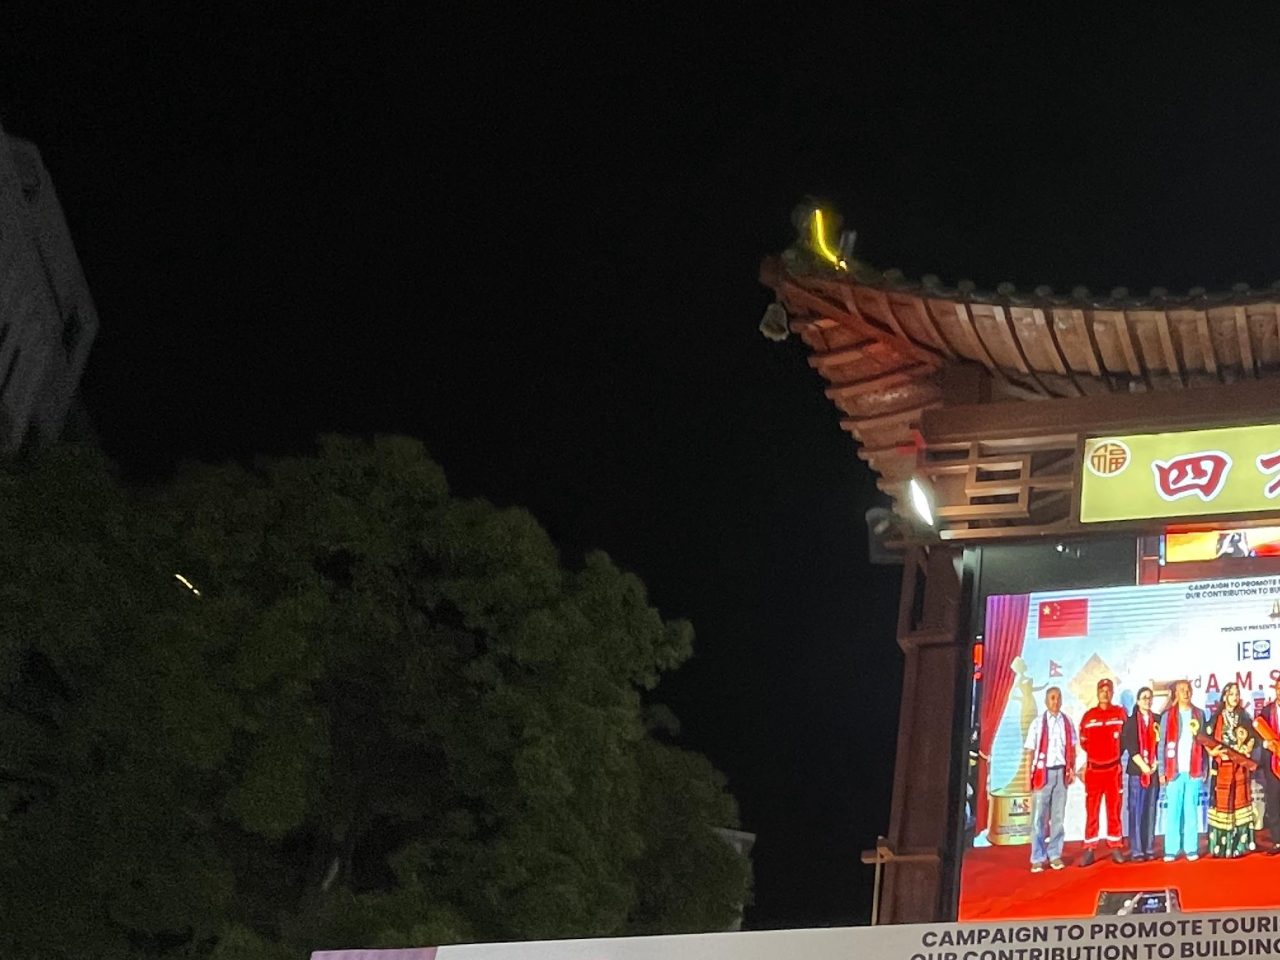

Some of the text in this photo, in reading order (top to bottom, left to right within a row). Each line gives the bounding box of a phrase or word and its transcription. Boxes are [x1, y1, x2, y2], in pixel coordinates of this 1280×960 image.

[922, 926, 1048, 948] CAMPAIGN
[1054, 924, 1085, 943] TO
[1090, 919, 1203, 941] PROMOTE
[1143, 941, 1175, 960] TO
